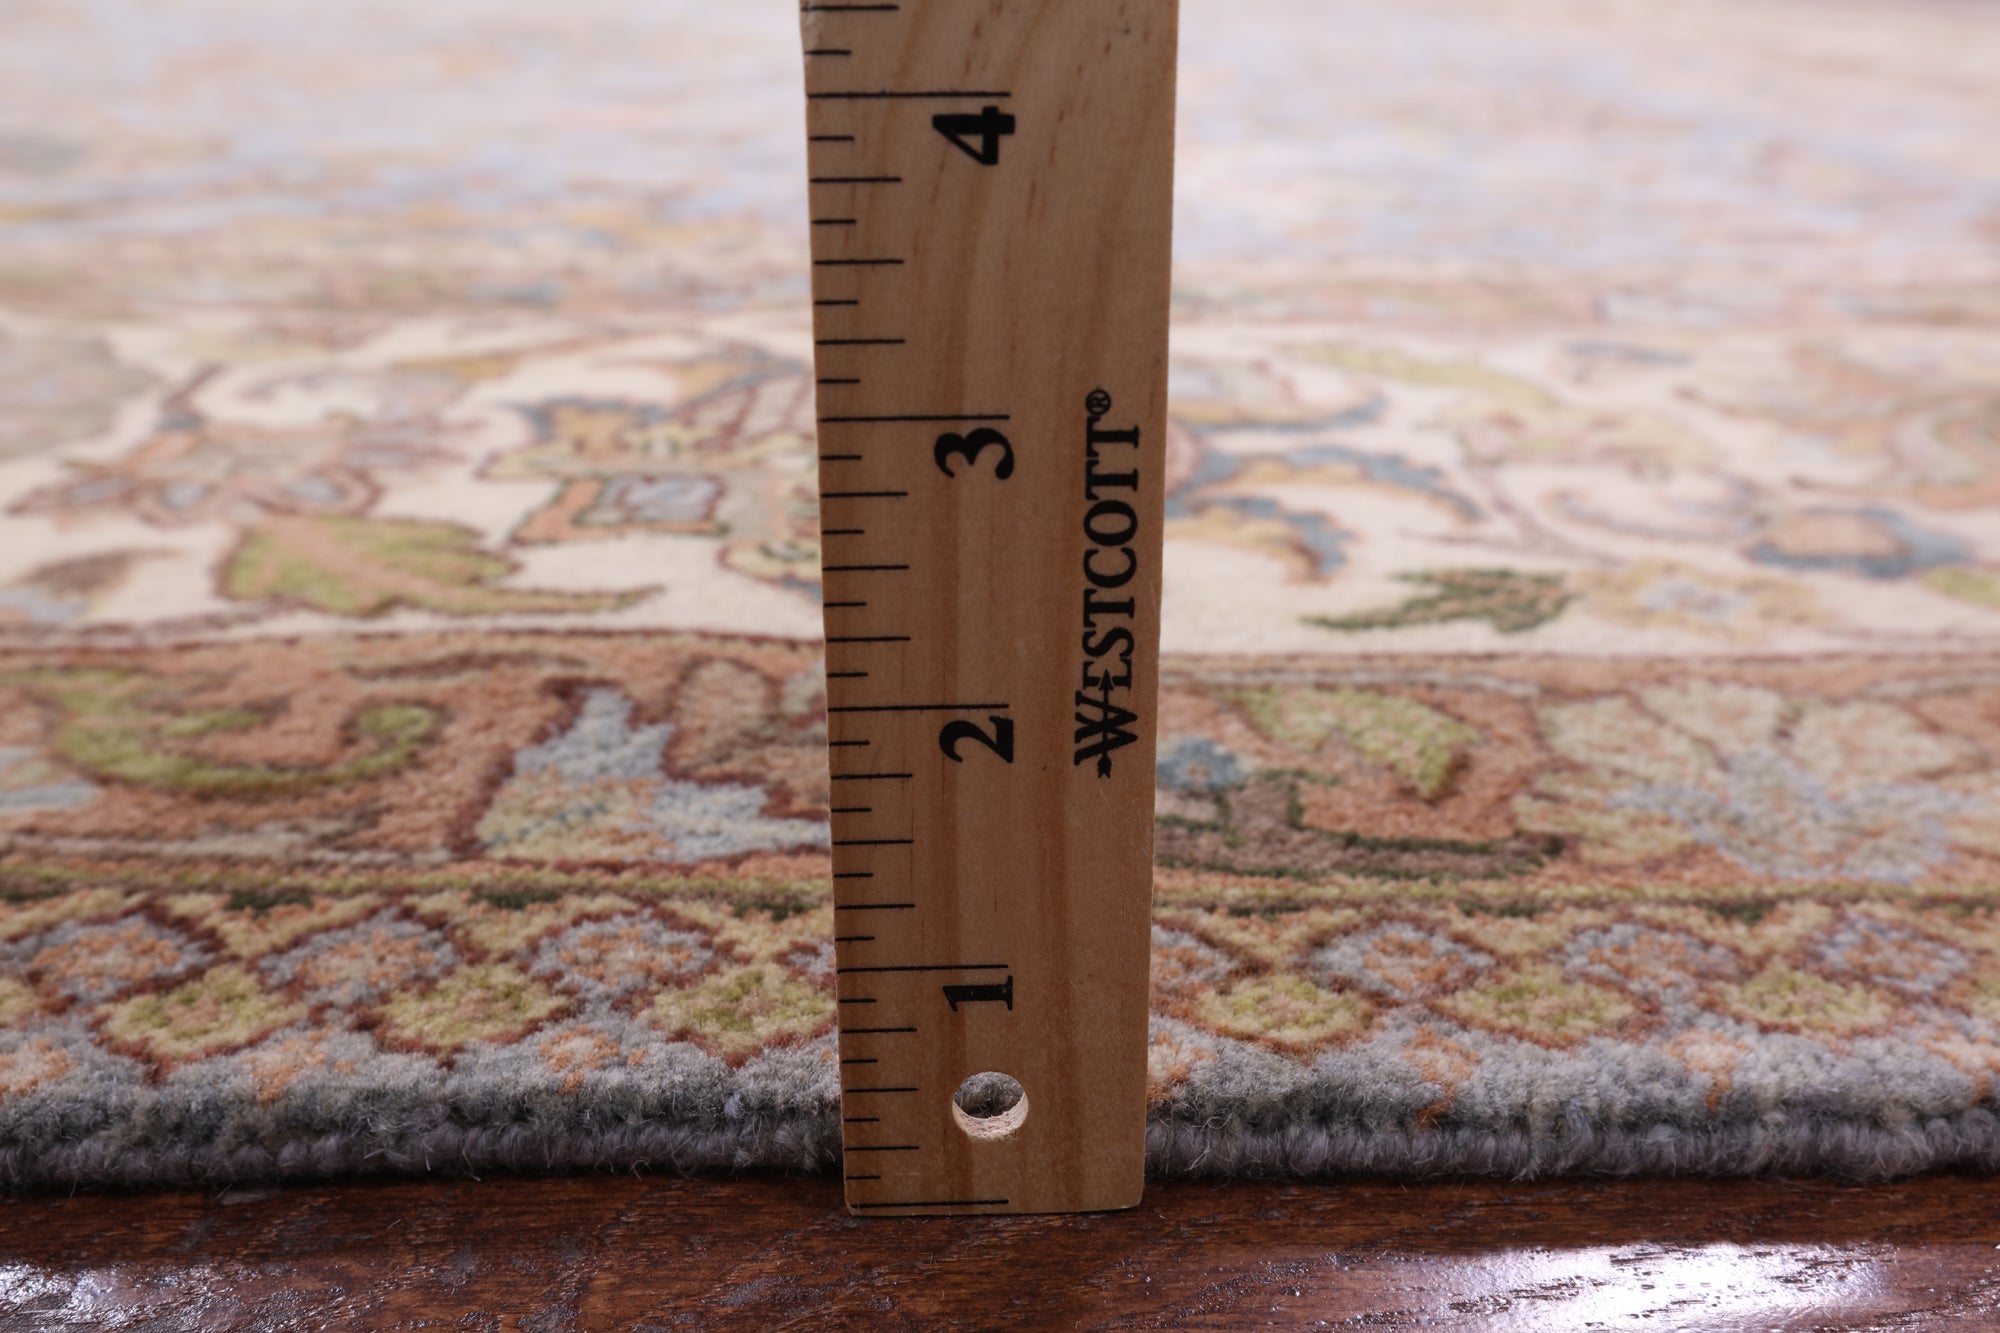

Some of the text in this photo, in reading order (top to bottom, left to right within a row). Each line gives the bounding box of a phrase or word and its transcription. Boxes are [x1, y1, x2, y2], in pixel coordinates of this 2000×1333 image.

[931, 105, 1017, 166] 4
[933, 427, 1016, 482] 3
[938, 715, 1015, 764] 2
[941, 974, 1015, 1013] 1
